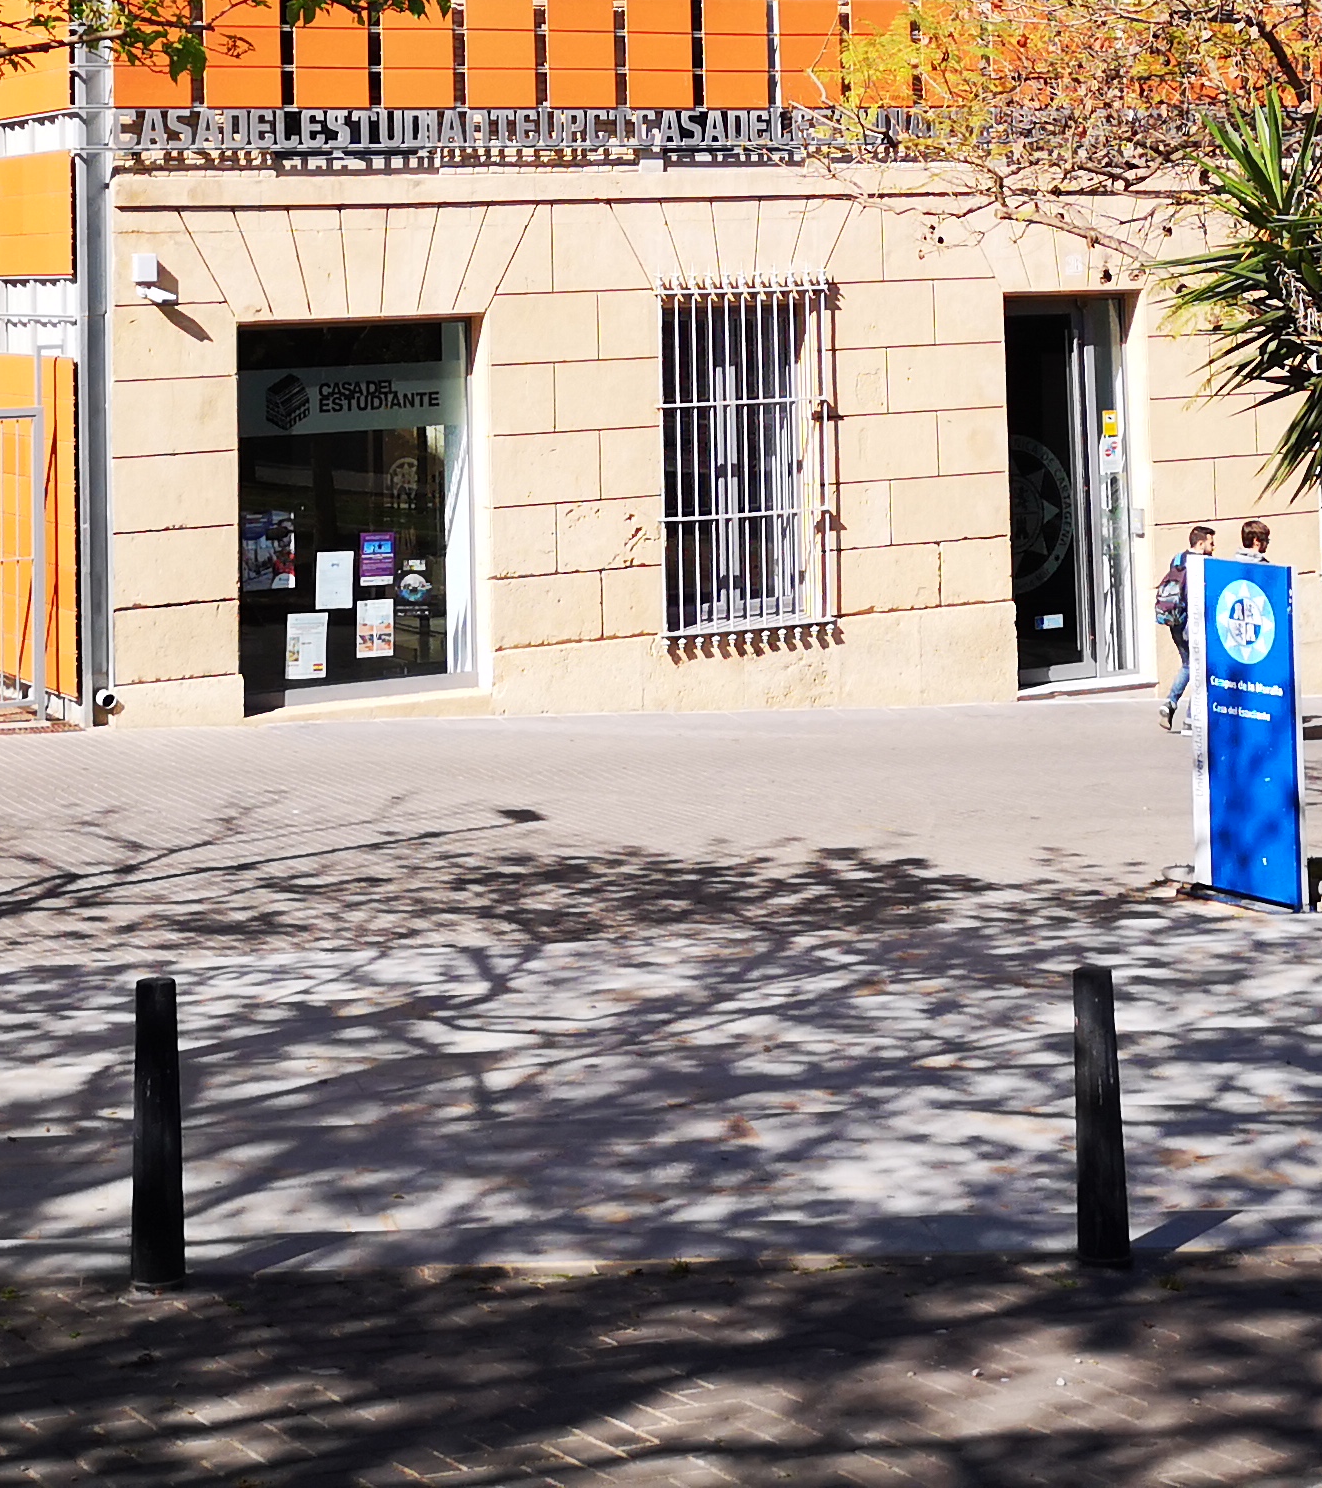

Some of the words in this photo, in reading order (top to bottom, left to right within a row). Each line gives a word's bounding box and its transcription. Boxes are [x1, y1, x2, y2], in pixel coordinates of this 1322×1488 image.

[319, 381, 363, 399] CASA
[365, 379, 396, 395] DEL
[319, 391, 440, 414] ESTUDIANTE
[1191, 638, 1200, 654] de
[1210, 675, 1237, 690] Campus
[1194, 725, 1205, 797] Universidad
